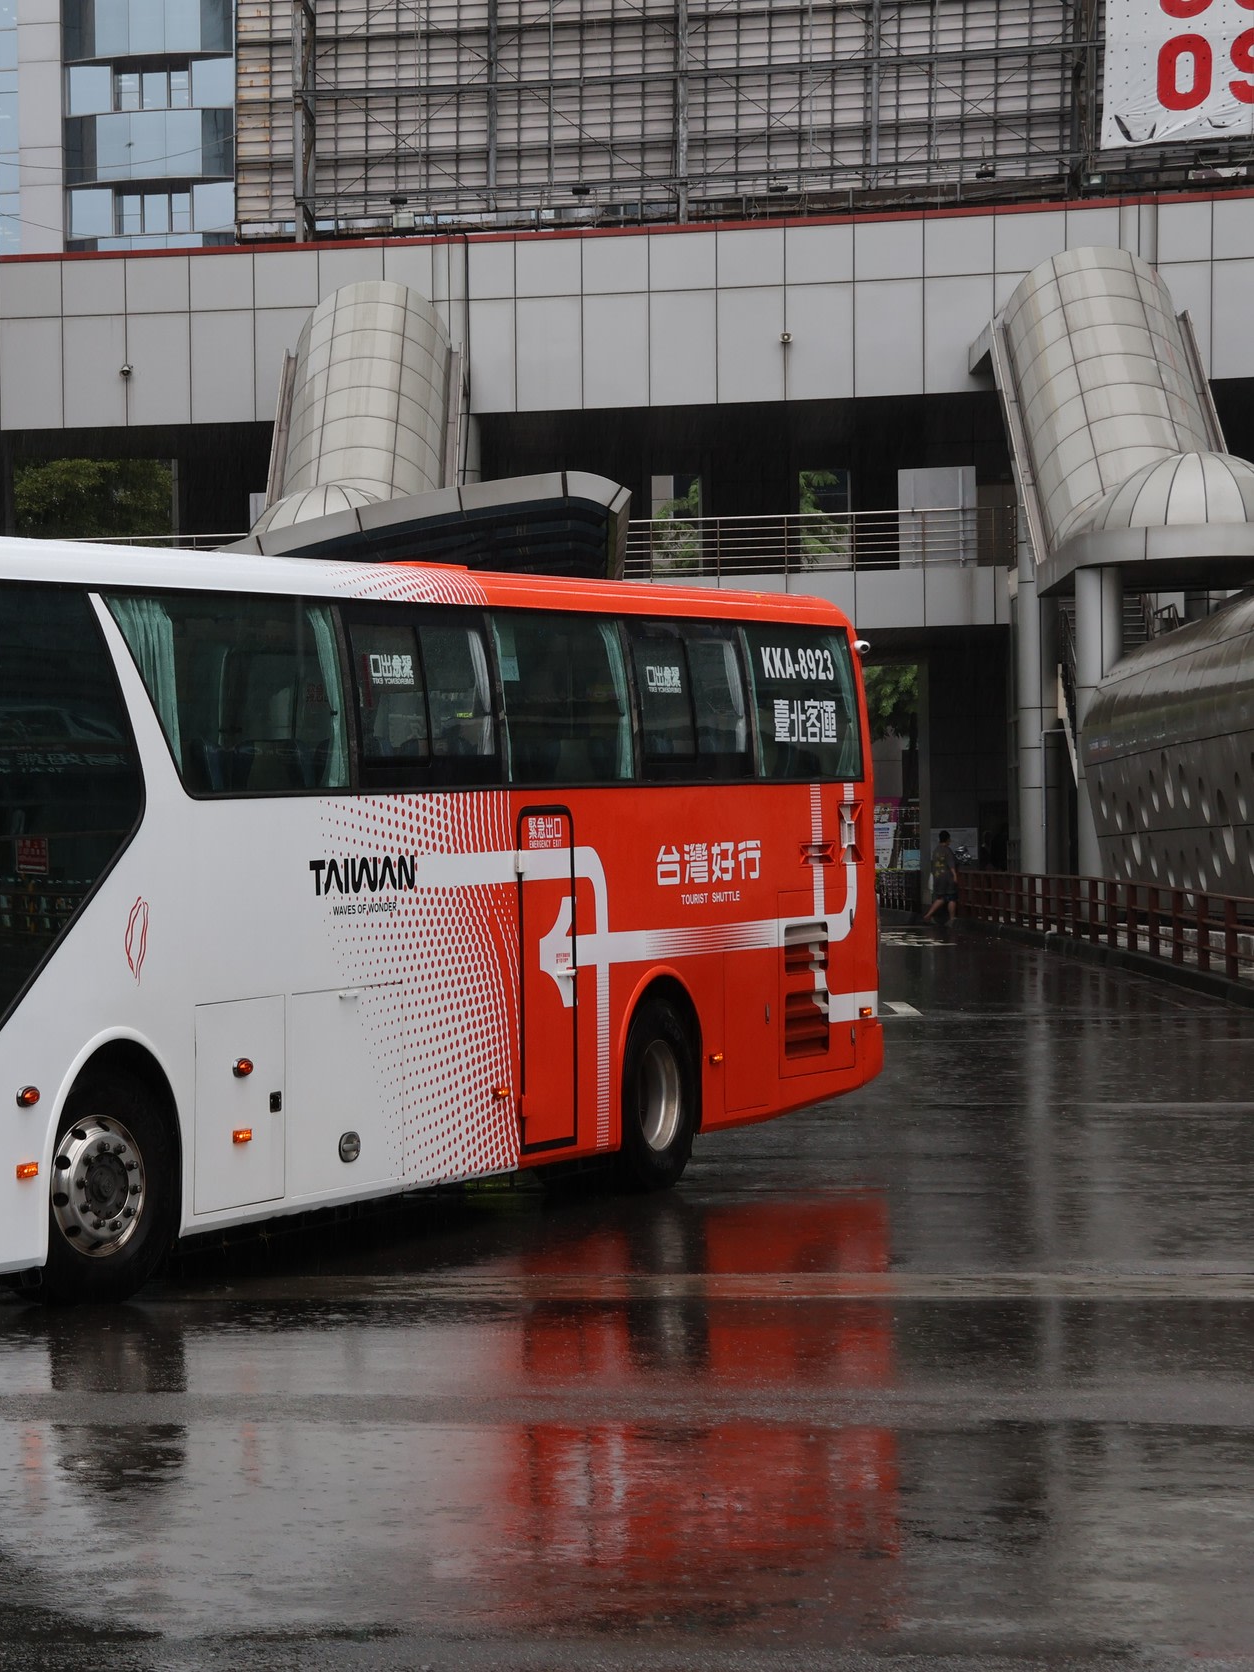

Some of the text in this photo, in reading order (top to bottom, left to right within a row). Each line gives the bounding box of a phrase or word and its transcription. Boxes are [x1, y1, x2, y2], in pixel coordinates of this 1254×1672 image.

[761, 647, 834, 680] KKA-8923
[774, 699, 837, 743] 臺北客運
[528, 817, 561, 839] 緊急出口
[309, 855, 415, 896] TAIWAN
[656, 840, 761, 886] 台灣好行
[333, 902, 397, 915] WAVES OF WONDER
[681, 891, 740, 905] TOURIST SHUTTLE
